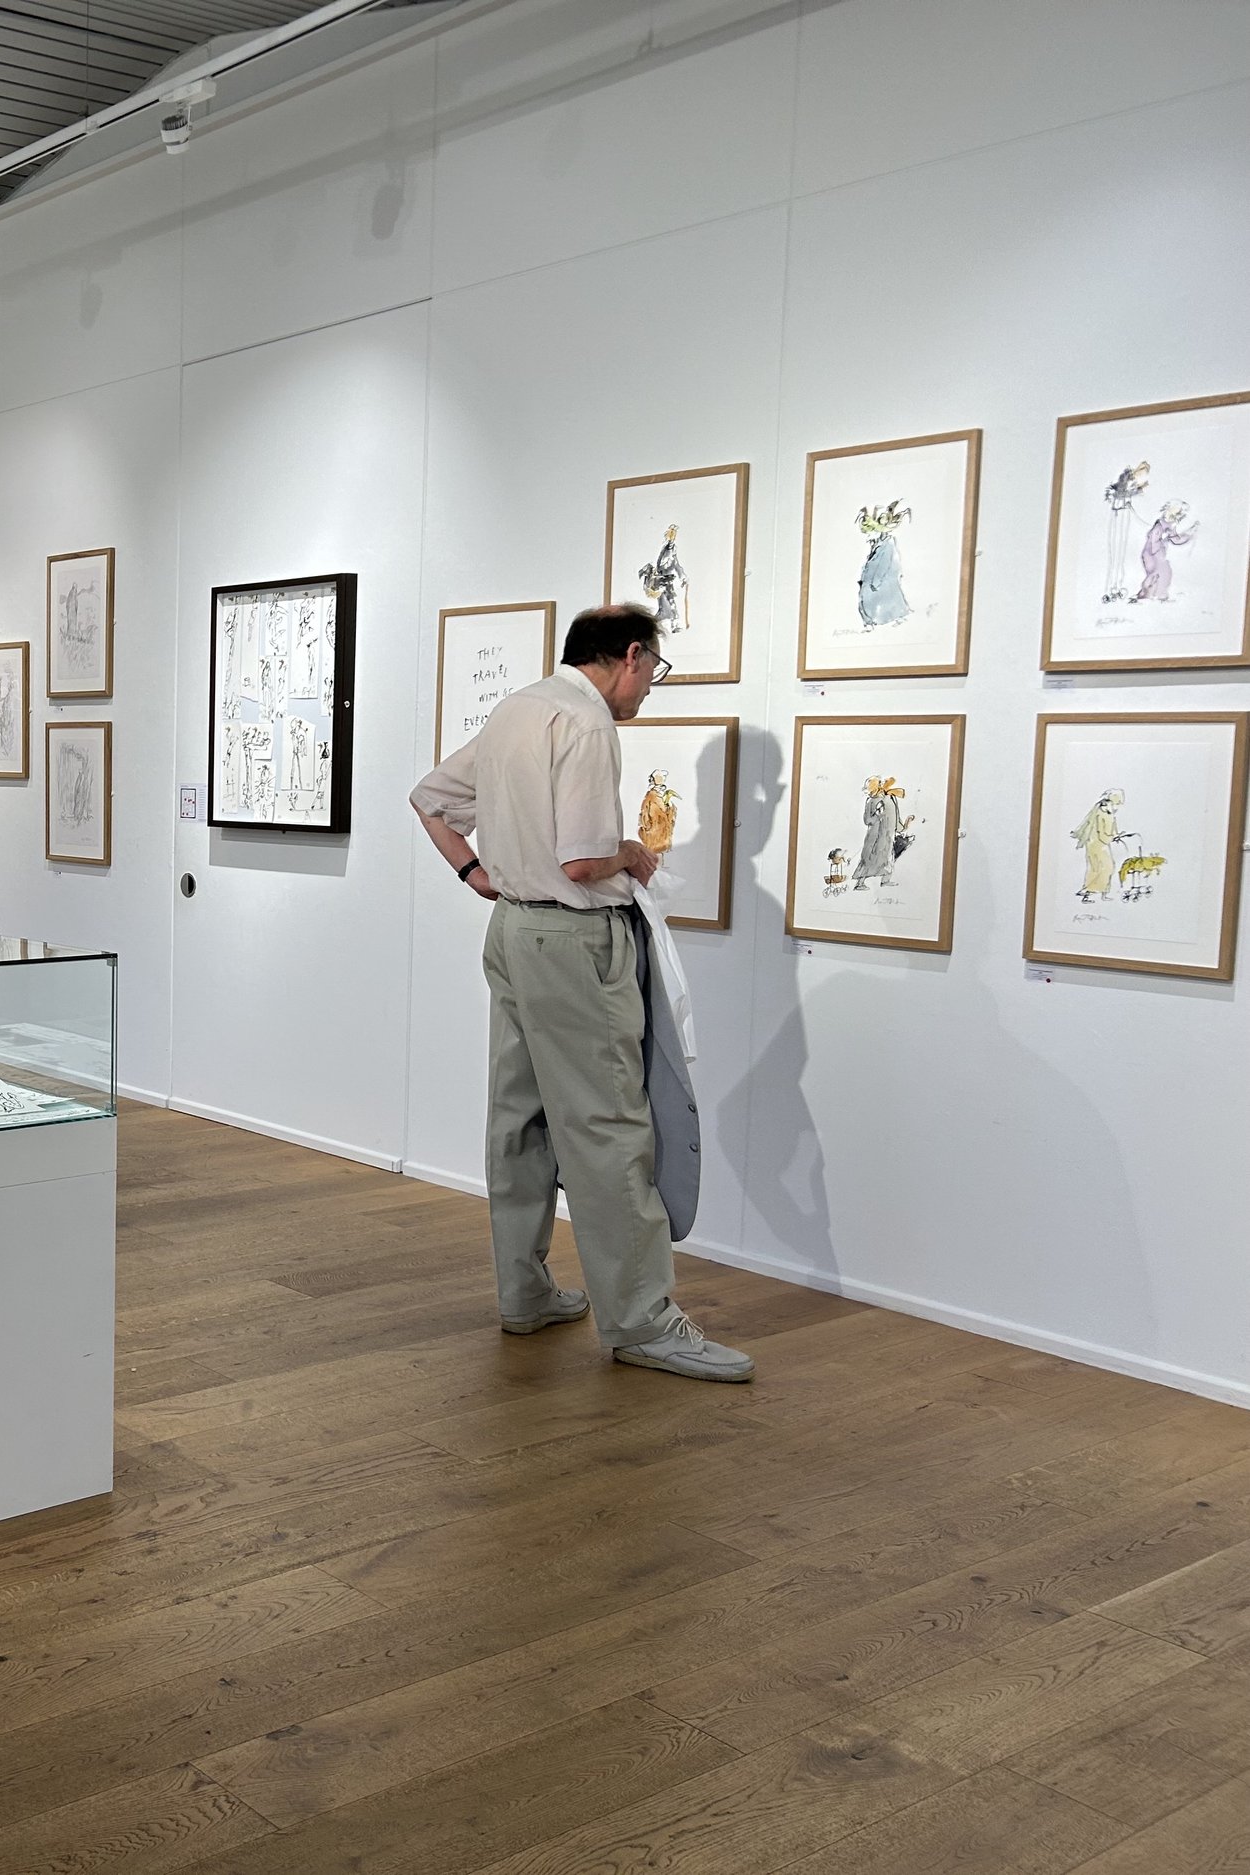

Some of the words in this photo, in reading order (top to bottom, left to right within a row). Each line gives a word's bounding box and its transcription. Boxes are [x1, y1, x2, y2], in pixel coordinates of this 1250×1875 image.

[477, 646, 502, 660] THEY
[472, 664, 507, 684] TRAVEL
[478, 691, 498, 702] WITH
[464, 714, 488, 731] EVER
